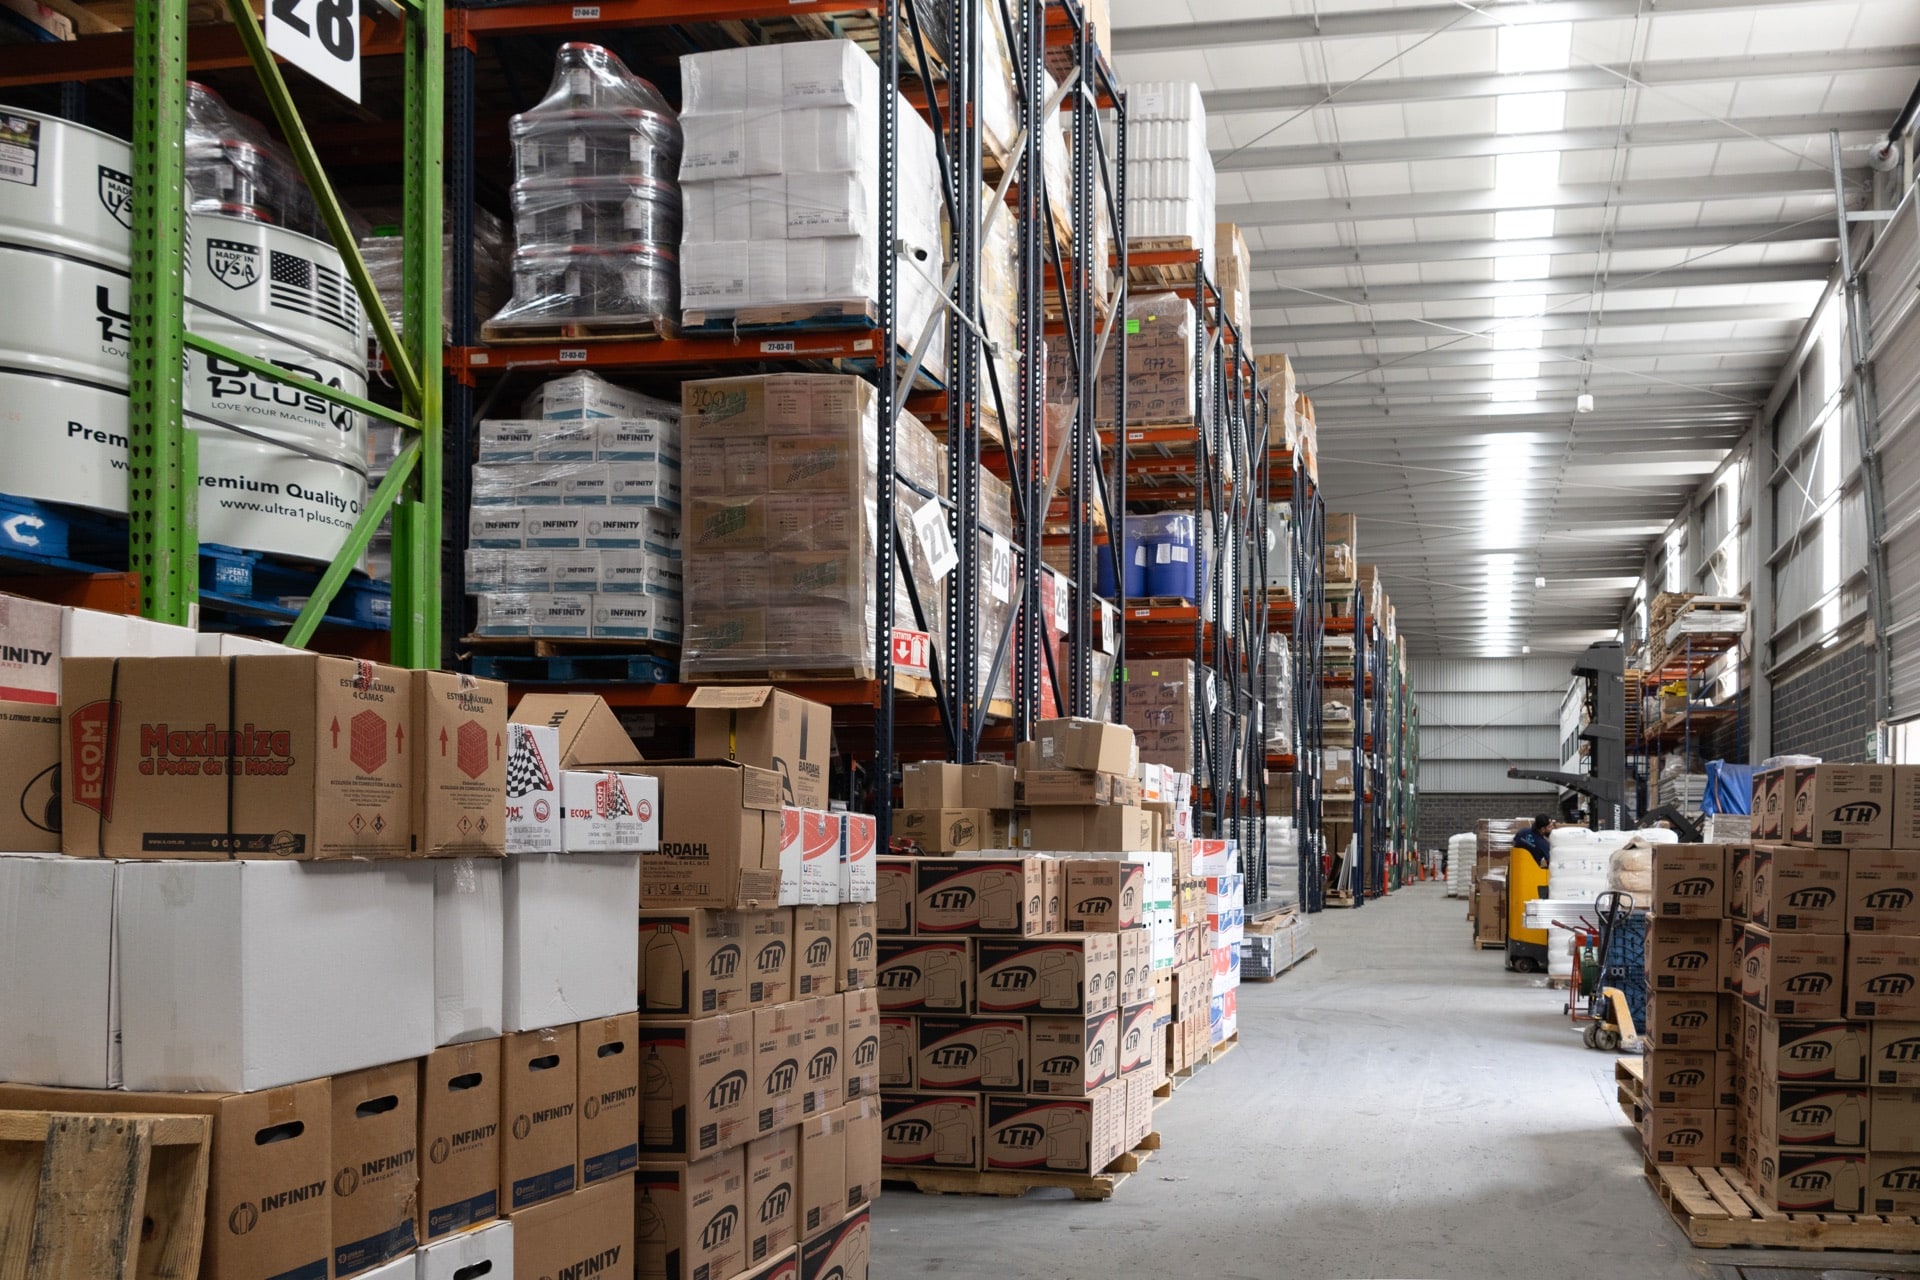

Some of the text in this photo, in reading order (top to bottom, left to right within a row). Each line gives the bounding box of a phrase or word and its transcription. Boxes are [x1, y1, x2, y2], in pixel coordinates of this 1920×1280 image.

[216, 250, 241, 260] MADE
[216, 259, 255, 278] USA
[561, 351, 586, 360] 27-03-02
[768, 343, 793, 352] 27-03-01
[211, 402, 327, 428] LOVE YOUR MACHINE
[68, 421, 130, 450] Prem
[497, 434, 532, 442] INFINITY
[616, 434, 654, 442] INFINITY
[198, 474, 279, 495] remium
[286, 482, 347, 513] Quality
[220, 498, 353, 530] www.ultra1plus.com
[485, 521, 520, 529] INFINITY
[542, 520, 578, 528] INFINITY
[602, 520, 640, 529] INFINITY
[922, 516, 950, 565] 27
[568, 566, 595, 574] INFINITY
[994, 548, 1008, 589] 26
[1056, 586, 1067, 620] 25
[548, 608, 586, 617] INFINITY
[610, 608, 647, 618] INFINITY
[893, 631, 912, 640] EXTINTOR
[1104, 614, 1112, 644] 24
[0, 645, 52, 666] INITY
[352, 692, 384, 702] 4 CAMAS
[463, 704, 484, 713] CAMAS
[140, 724, 290, 758] Maximiza
[80, 720, 101, 800] ECOM
[139, 758, 154, 776] el
[157, 758, 200, 776] Poder
[202, 758, 222, 776] de
[798, 760, 820, 774] BARDAHL
[1796, 798, 1806, 812] LTH
[1834, 808, 1872, 822] LTH
[642, 844, 710, 858] ARDAHL
[1673, 883, 1707, 896] LTH
[930, 894, 968, 908] LTH
[1029, 901, 1039, 914] LTH
[1077, 902, 1106, 914] LTH
[1789, 894, 1828, 908] LTH
[1866, 894, 1905, 908] LTH
[806, 945, 828, 964] LTH
[852, 940, 870, 958] LTH
[710, 956, 736, 976] LTH
[758, 952, 780, 970] LTH
[1668, 957, 1700, 968] LTH
[1746, 960, 1758, 974] LTH
[878, 972, 914, 988] LTH
[992, 972, 1028, 988] LTH
[1090, 980, 1100, 994] LTH
[1786, 979, 1826, 992] LTH
[1868, 979, 1908, 994] LTH
[1672, 1015, 1700, 1026] LTH
[1126, 1033, 1138, 1050] LTH
[855, 1044, 874, 1066] LTH
[932, 1050, 970, 1066] LTH
[1090, 1046, 1103, 1063] LTH
[1790, 1046, 1824, 1059] LTH
[808, 1054, 832, 1080] LTH
[1042, 1060, 1072, 1074] LTH
[767, 1068, 793, 1094] LTH
[1668, 1074, 1698, 1085] LTH
[602, 1086, 637, 1104] INFINITY
[710, 1079, 740, 1110] LTH
[532, 1104, 574, 1124] INFINITY
[1791, 1110, 1824, 1123] LTH
[452, 1124, 497, 1147] INFINITY
[888, 1125, 925, 1142] LTH
[998, 1130, 1035, 1146] LTH
[1668, 1134, 1697, 1144] LTH
[362, 1148, 416, 1177] INFINITY
[1762, 1162, 1773, 1182] LTH
[1790, 1176, 1824, 1189] LTH
[262, 1180, 326, 1213] INFINITY
[760, 1197, 786, 1223] LTH
[702, 1222, 732, 1250] LTH
[558, 1245, 622, 1280] INFINITY
